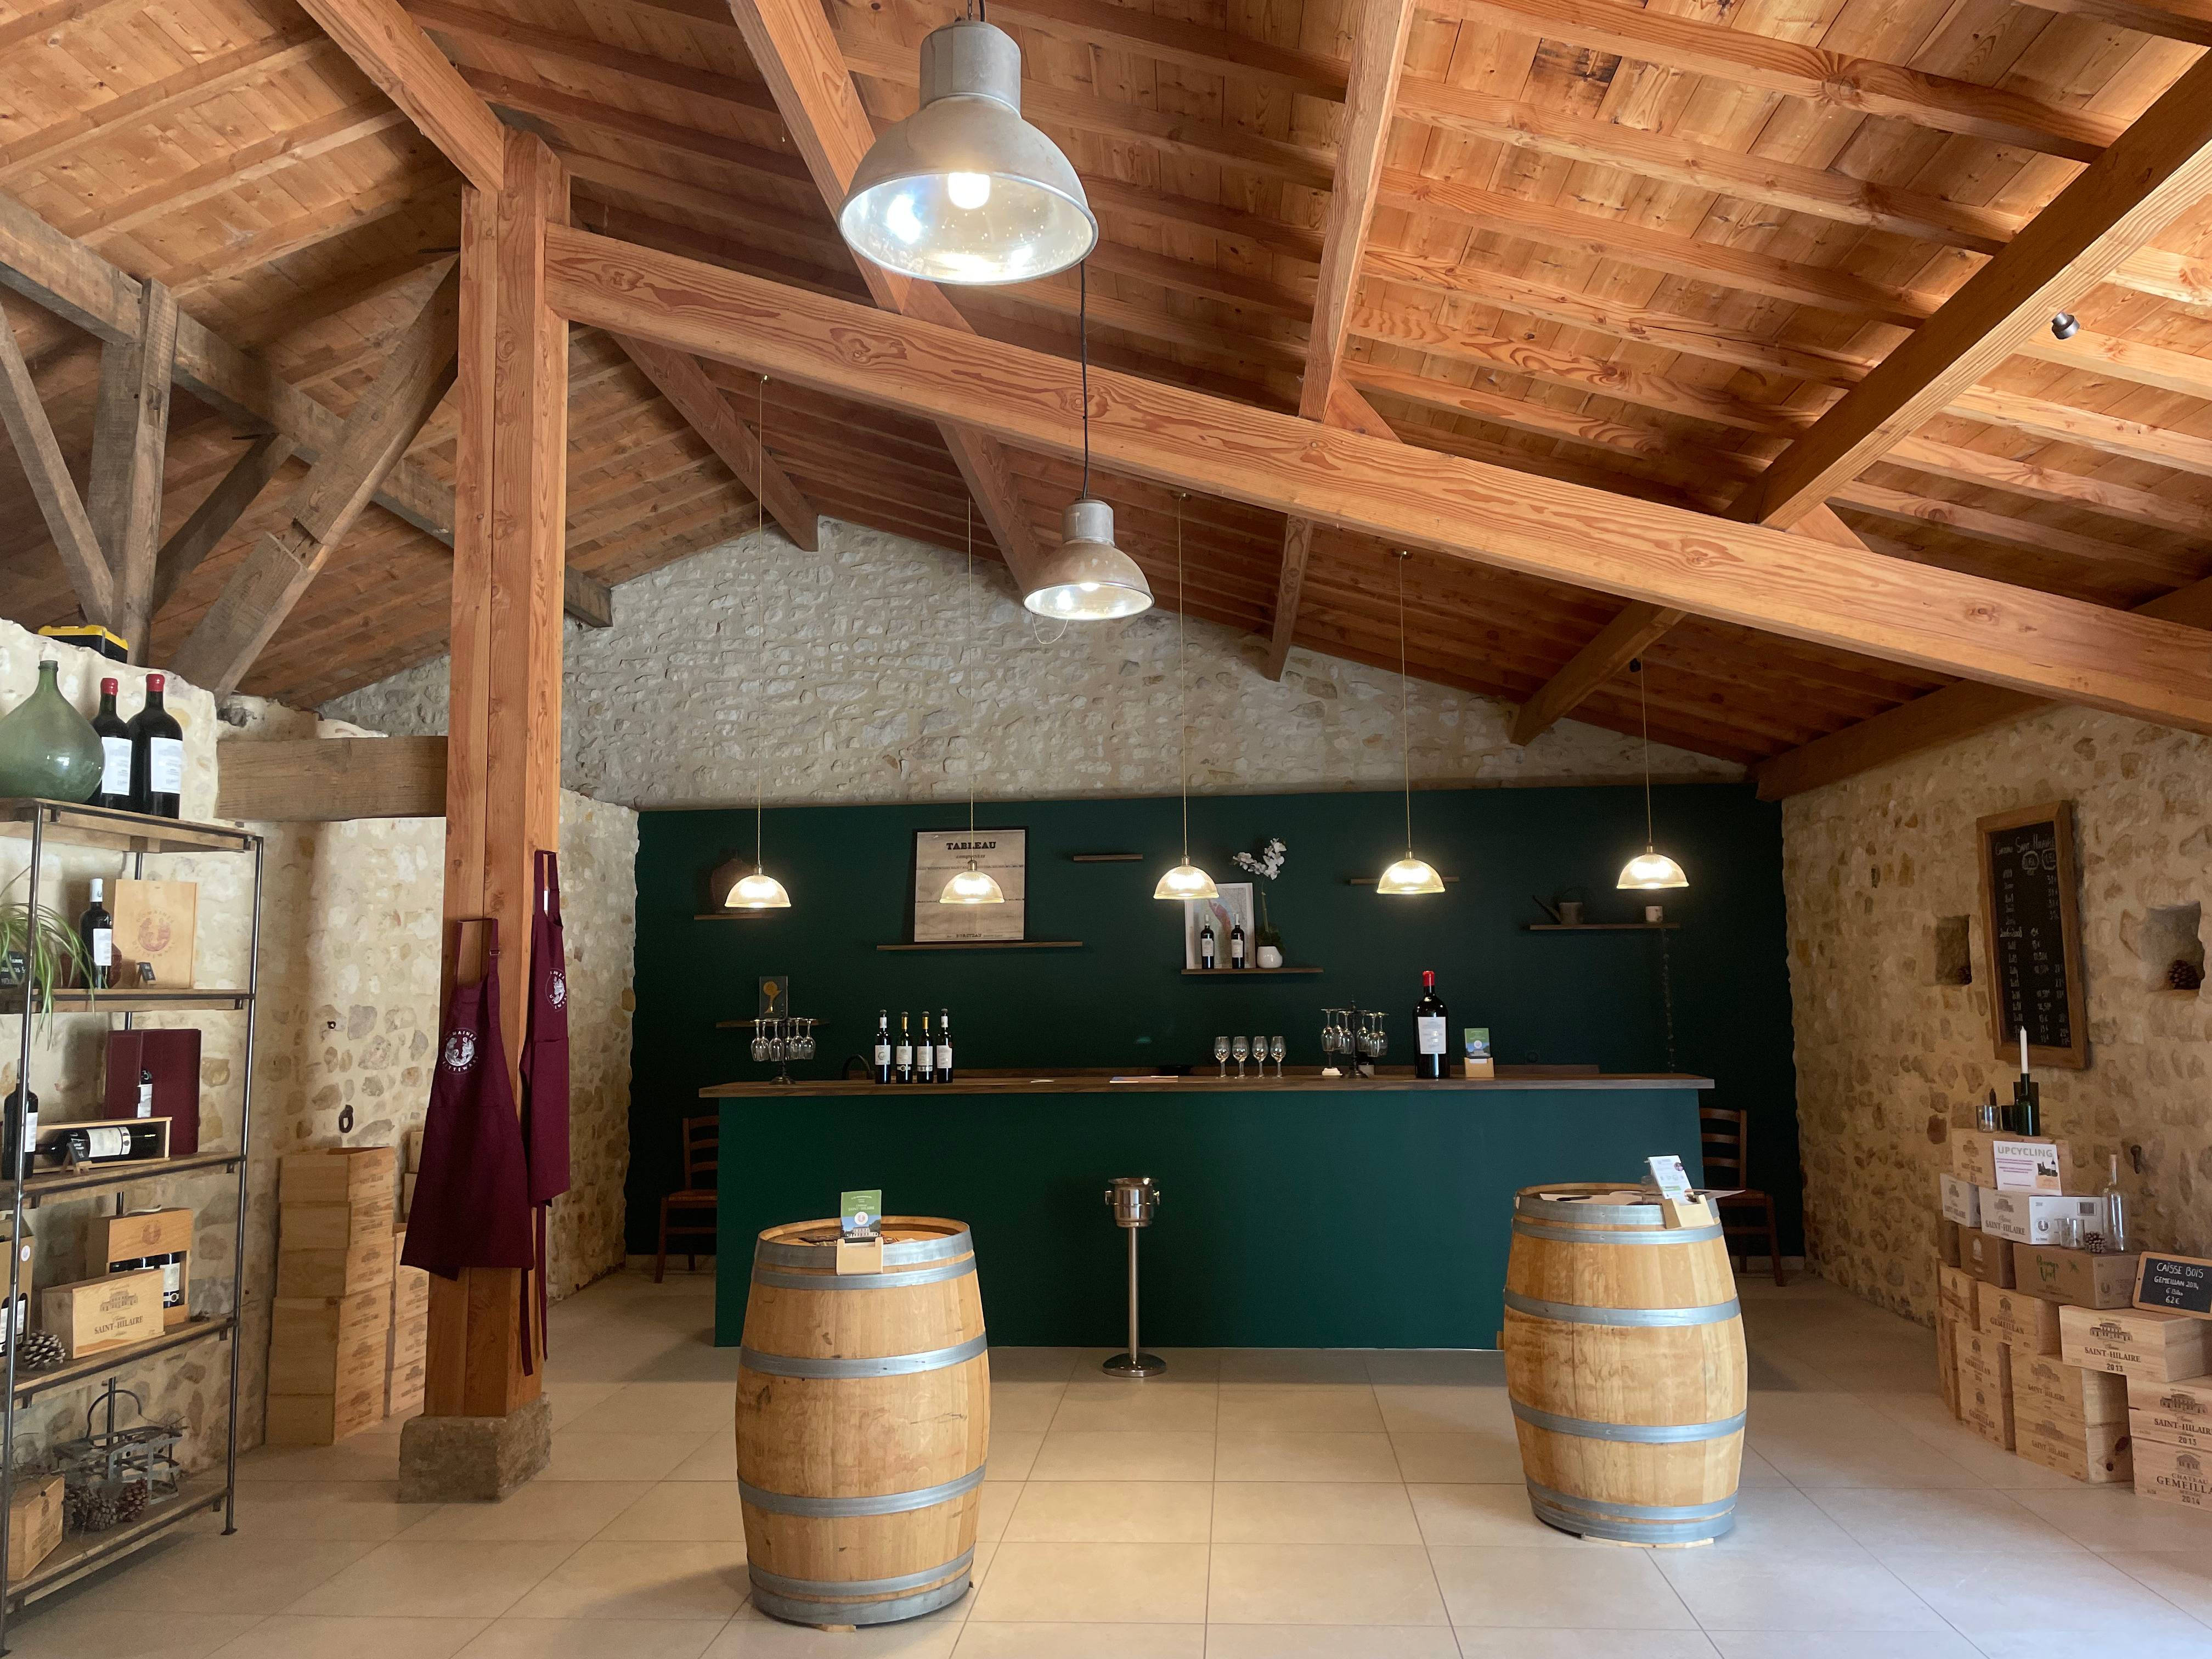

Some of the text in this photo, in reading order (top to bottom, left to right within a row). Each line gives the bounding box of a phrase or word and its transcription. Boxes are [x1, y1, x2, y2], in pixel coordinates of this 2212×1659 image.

[946, 842, 996, 850] TABLEAU
[1997, 1146, 2053, 1158] UPCYCLING
[2107, 1363, 2123, 1372] 2013
[2154, 1418, 2212, 1436] SAINT-HILAIR
[2178, 1436, 2197, 1446] 2013
[2181, 1495, 2200, 1505] 2014
